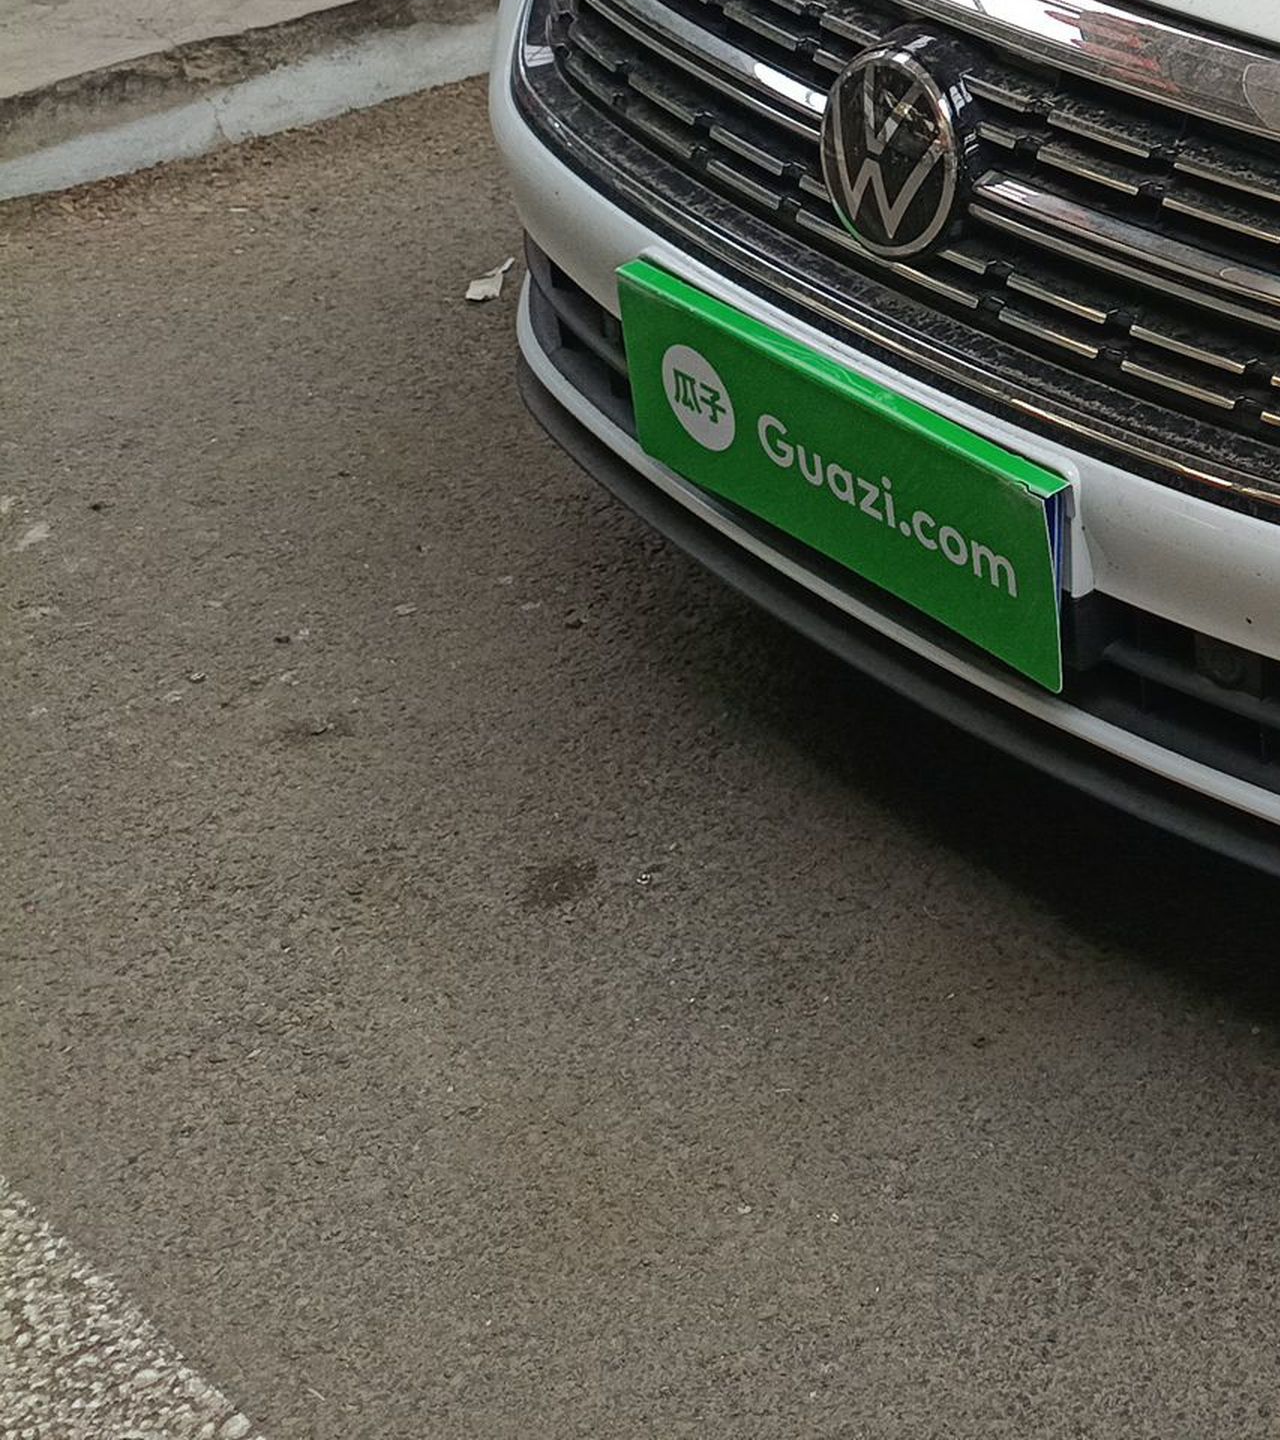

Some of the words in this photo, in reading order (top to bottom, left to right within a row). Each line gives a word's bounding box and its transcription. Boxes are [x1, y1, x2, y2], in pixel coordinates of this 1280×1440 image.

[831, 58, 948, 240] VW
[673, 368, 728, 425] 瓜子
[756, 413, 1019, 599] Guazi.com
